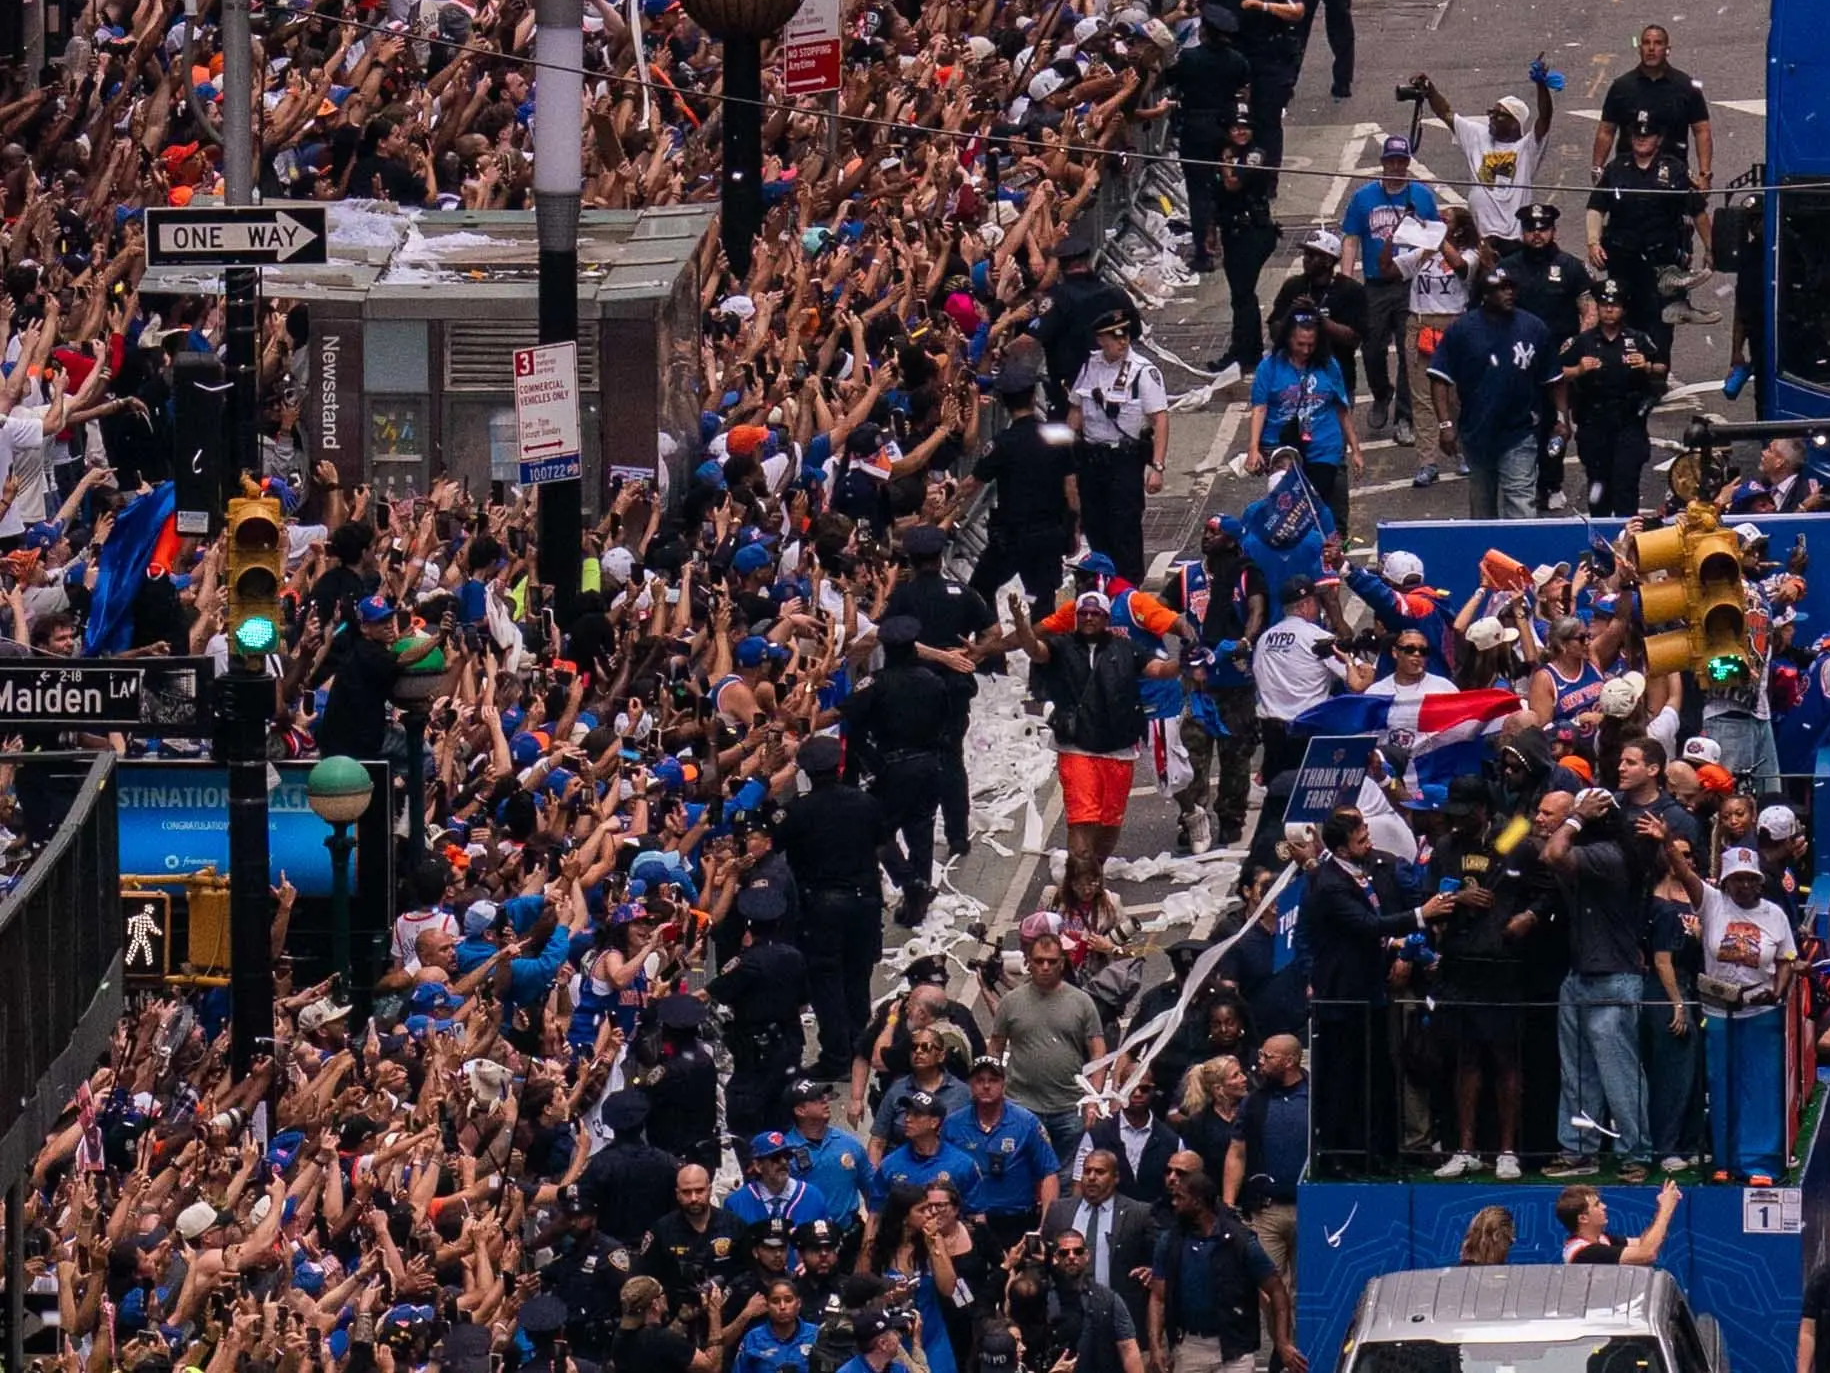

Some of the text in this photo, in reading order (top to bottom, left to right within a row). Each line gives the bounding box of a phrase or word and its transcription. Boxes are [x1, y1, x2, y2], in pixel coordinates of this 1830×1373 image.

[787, 43, 833, 59] NO STOPPING
[788, 59, 816, 72] Anytime
[173, 225, 299, 249] ONE WAY
[519, 352, 530, 374] 3
[322, 335, 341, 450] Newsstand
[519, 380, 565, 395] COMMERCIAL
[520, 389, 569, 407] VEHICLES ONLY
[529, 464, 567, 483] 100722
[1265, 631, 1296, 647] NYPD
[59, 670, 83, 684] 2-18
[0, 680, 130, 714] Maiden LA
[1301, 766, 1365, 788] THANK YOU
[1303, 788, 1339, 809] FANS!
[1757, 1207, 1769, 1229] 1
